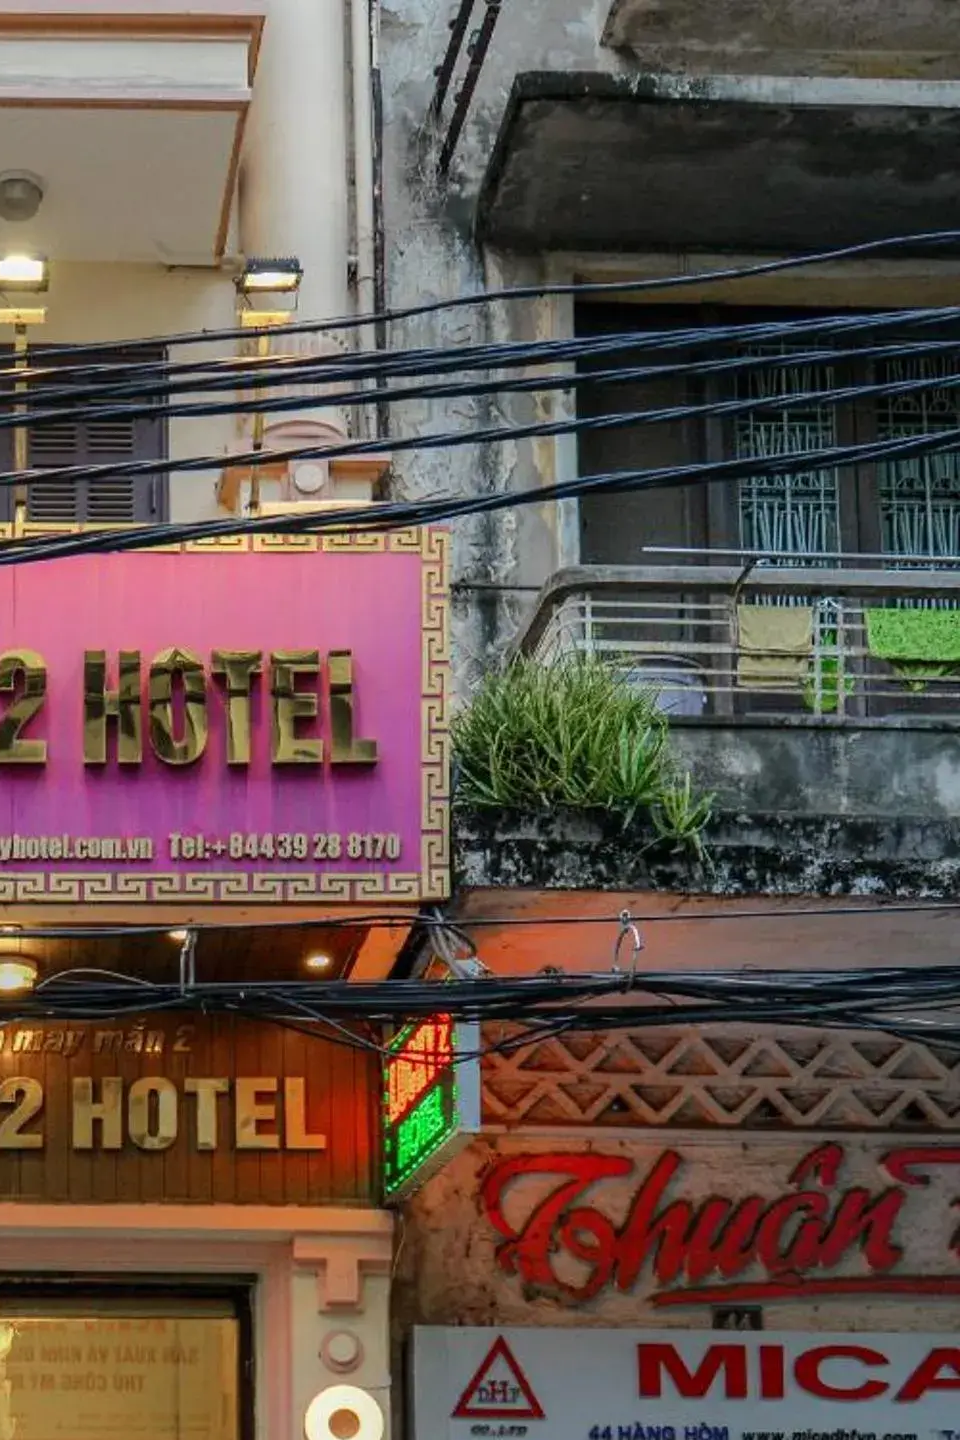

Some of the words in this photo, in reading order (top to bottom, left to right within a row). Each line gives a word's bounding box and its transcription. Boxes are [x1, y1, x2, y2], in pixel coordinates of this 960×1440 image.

[82, 646, 380, 767] HOTEL
[312, 832, 342, 861] 28
[346, 832, 401, 861] 8170
[172, 1024, 196, 1052] 2
[71, 1076, 327, 1150] HOTEL
[636, 1343, 960, 1403] MICA
